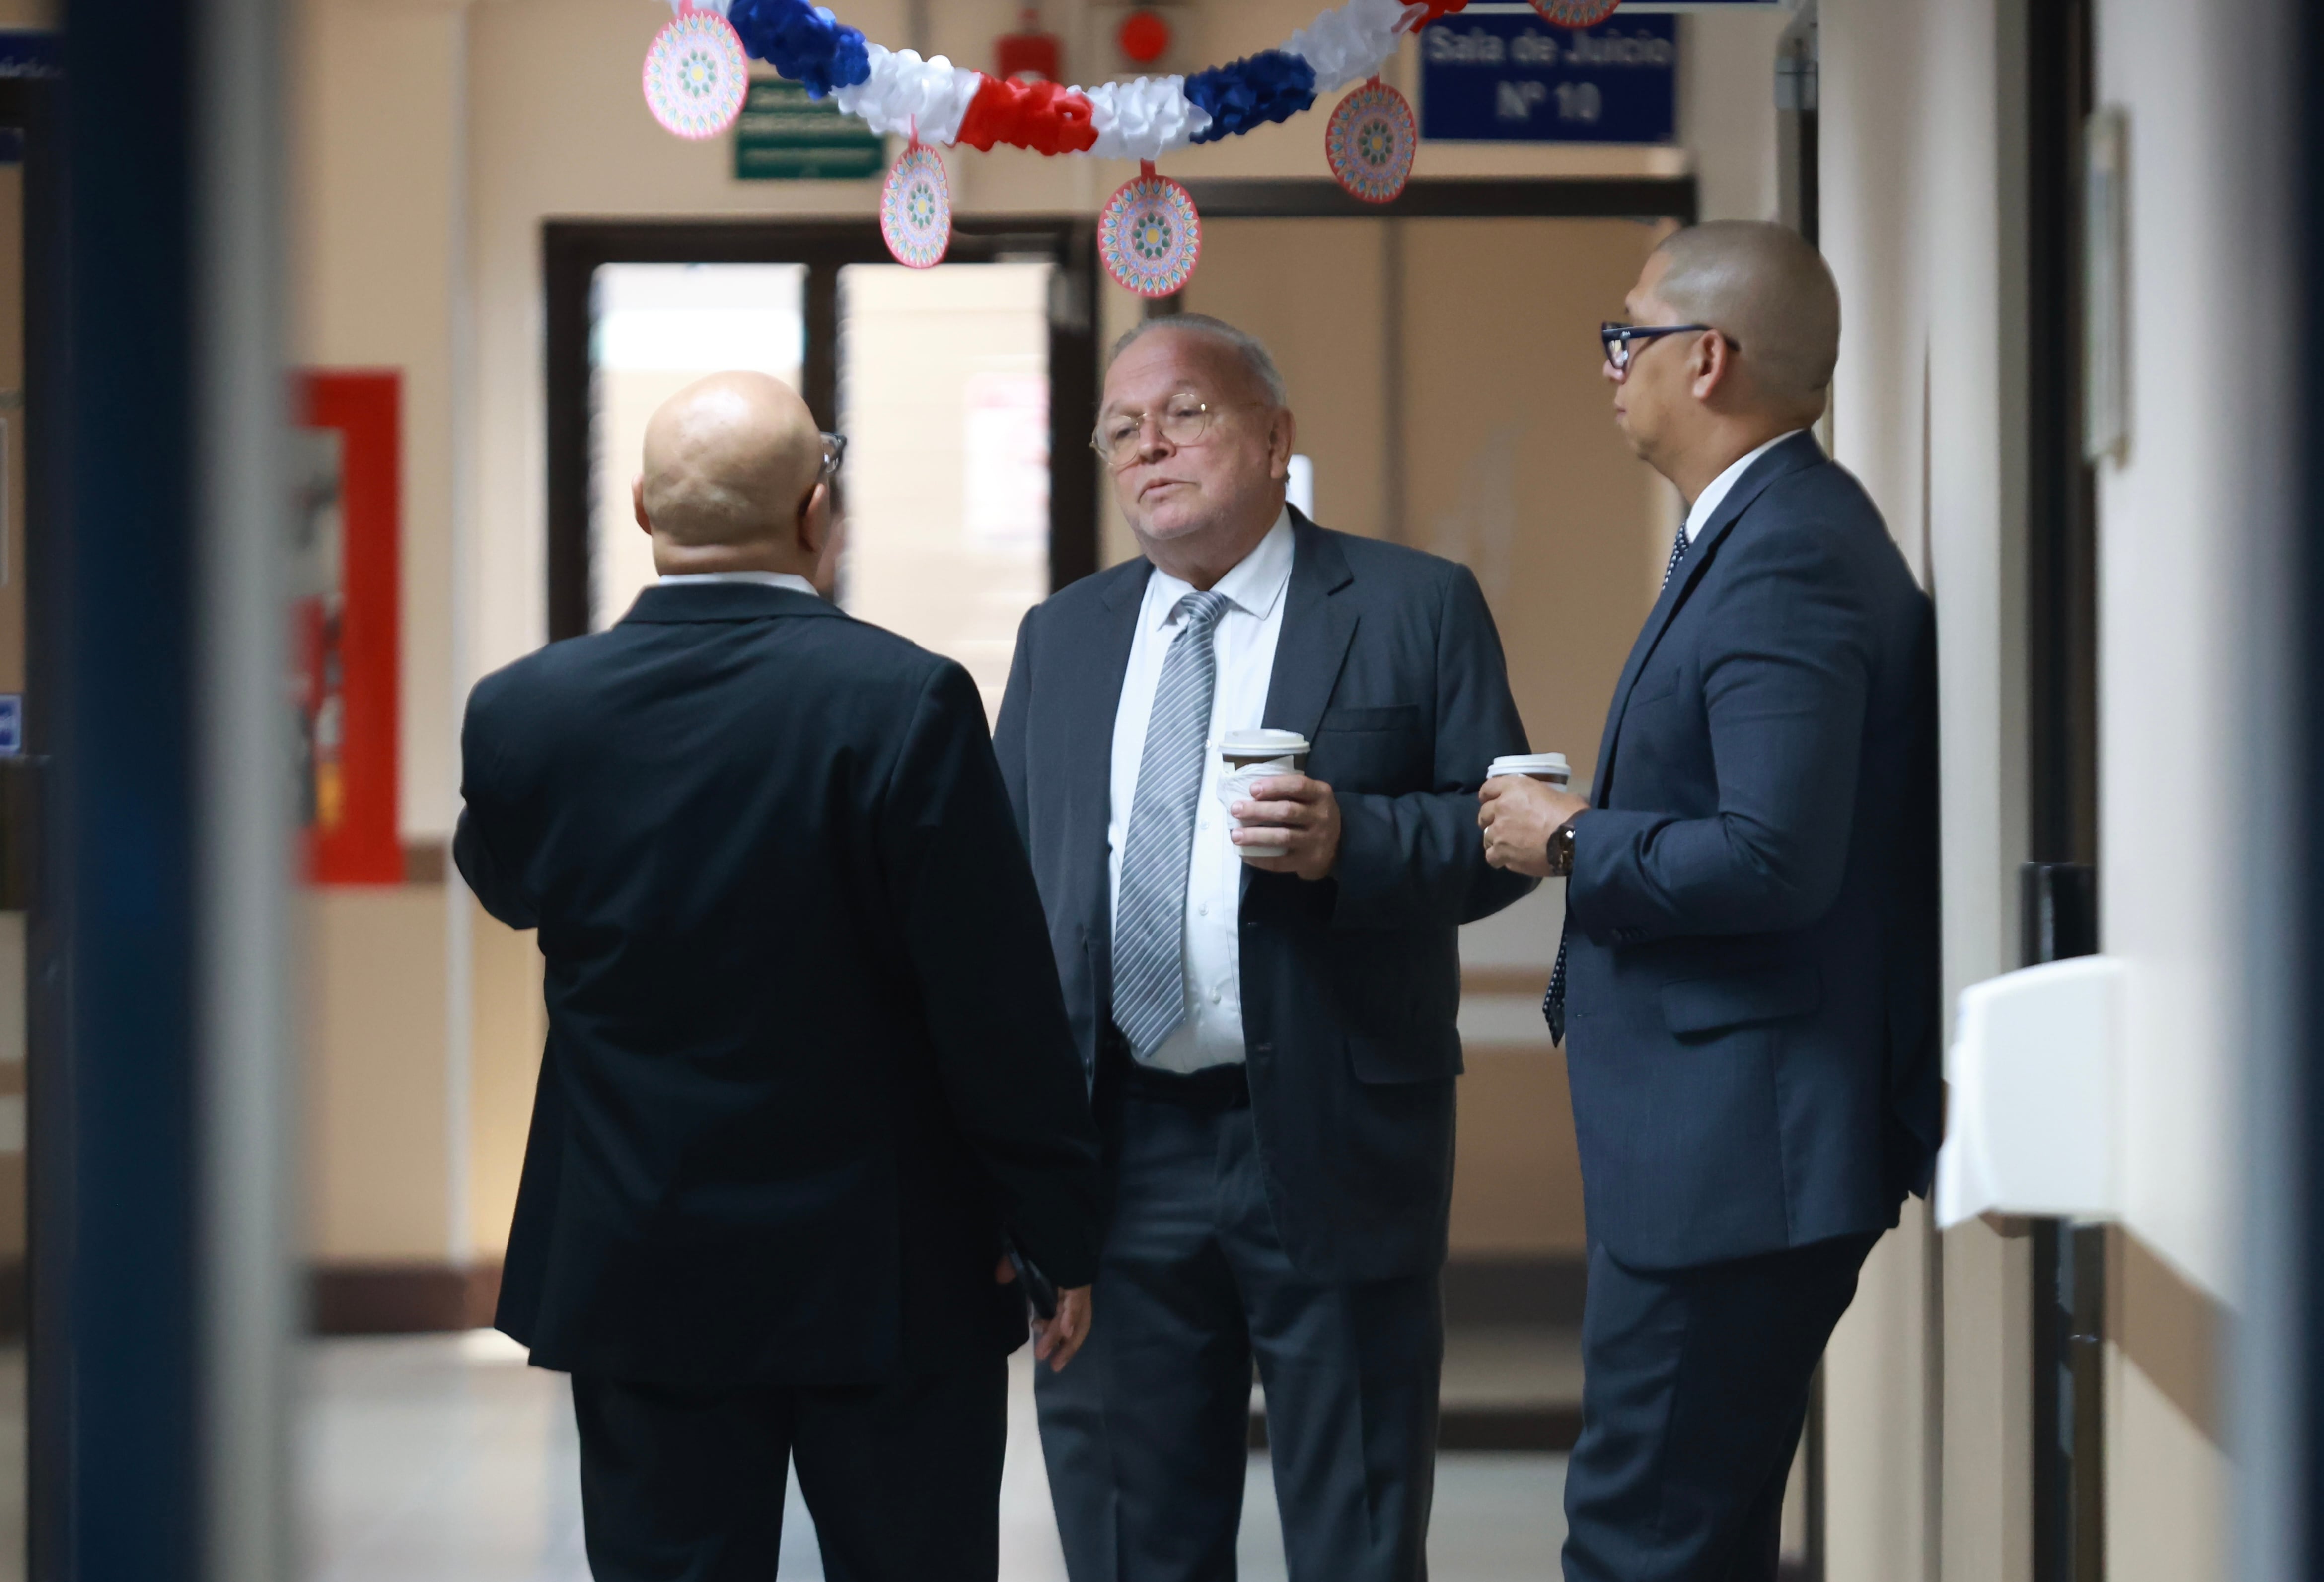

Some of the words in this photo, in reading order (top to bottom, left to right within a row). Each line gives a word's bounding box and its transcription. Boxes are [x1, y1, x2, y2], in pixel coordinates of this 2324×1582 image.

[1428, 27, 1504, 63] Sala
[1510, 28, 1558, 63] de
[1565, 30, 1672, 64] Juicio
